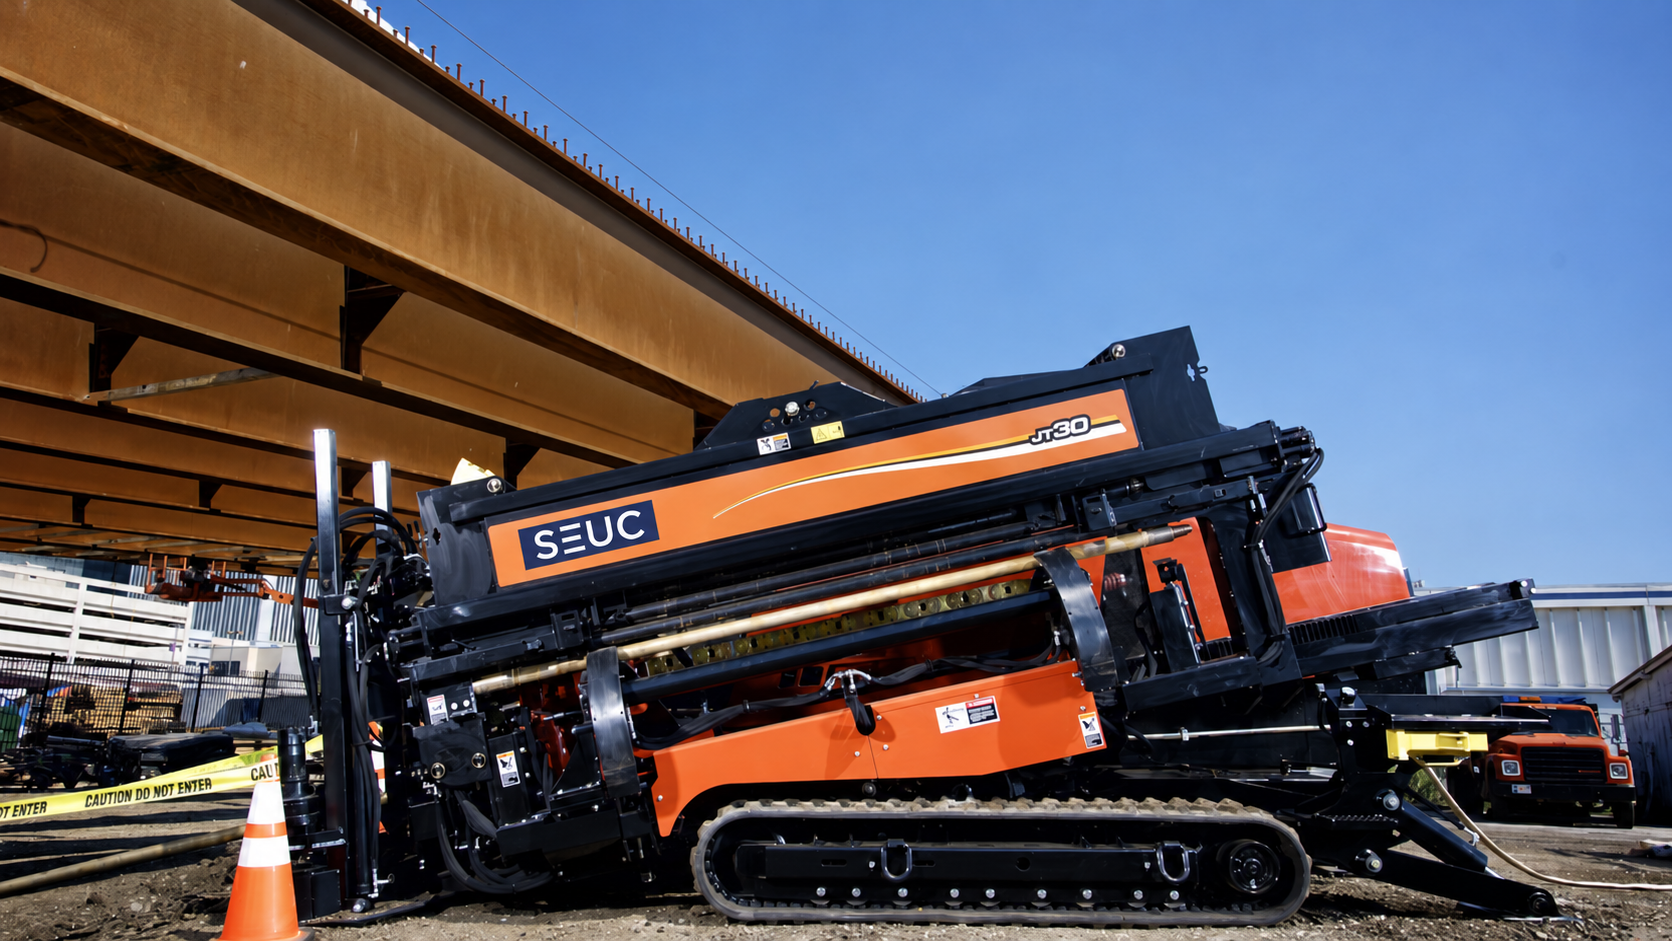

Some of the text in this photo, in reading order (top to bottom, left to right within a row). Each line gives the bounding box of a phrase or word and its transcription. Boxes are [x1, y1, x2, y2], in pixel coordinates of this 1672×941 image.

[1029, 414, 1091, 445] JT30
[534, 510, 645, 560] SEUC
[85, 777, 213, 807] CAUTION DO NOT ENTER
[12, 801, 48, 818] ENTER
